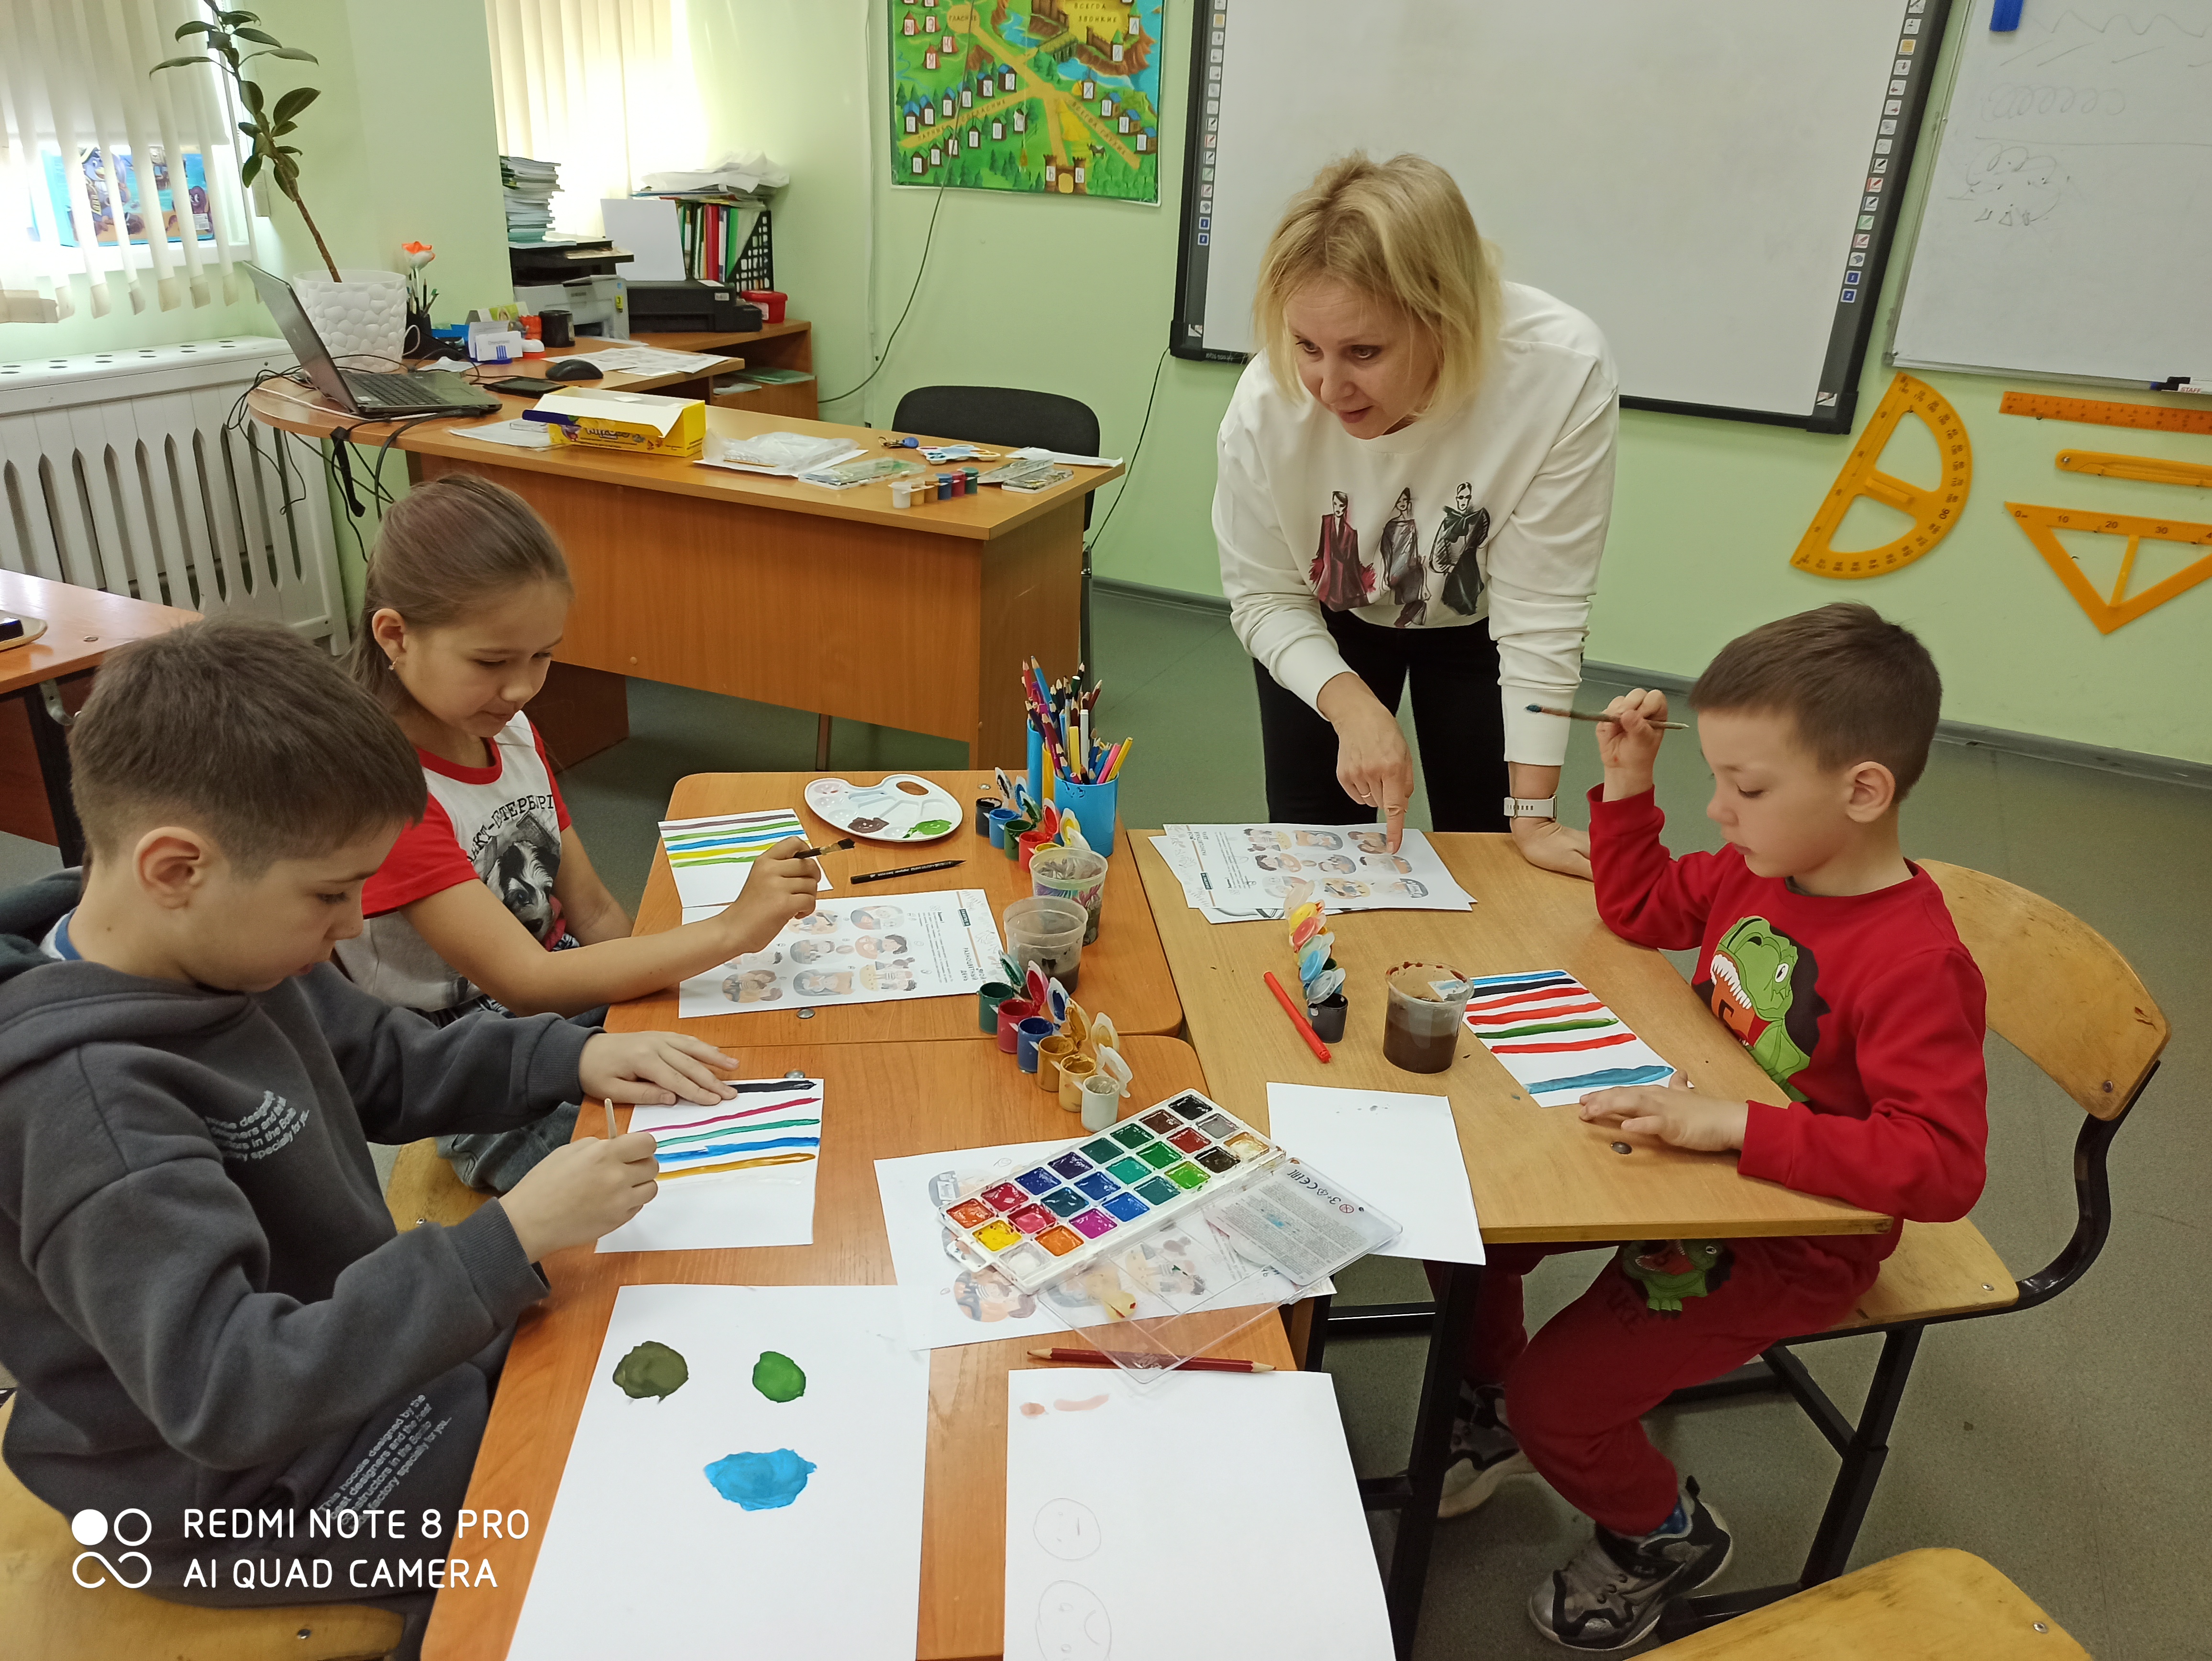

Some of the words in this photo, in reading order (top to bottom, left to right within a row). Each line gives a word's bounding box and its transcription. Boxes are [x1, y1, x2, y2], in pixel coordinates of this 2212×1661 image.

[1938, 508, 1950, 520] 90
[2057, 515, 2069, 523] 10
[2105, 520, 2118, 529] 20
[2155, 526, 2168, 534] 30
[339, 1458, 370, 1491] hoodie
[369, 1418, 404, 1457] designed
[349, 1450, 391, 1495] designers
[389, 1431, 406, 1451] and
[368, 1476, 400, 1510] factory
